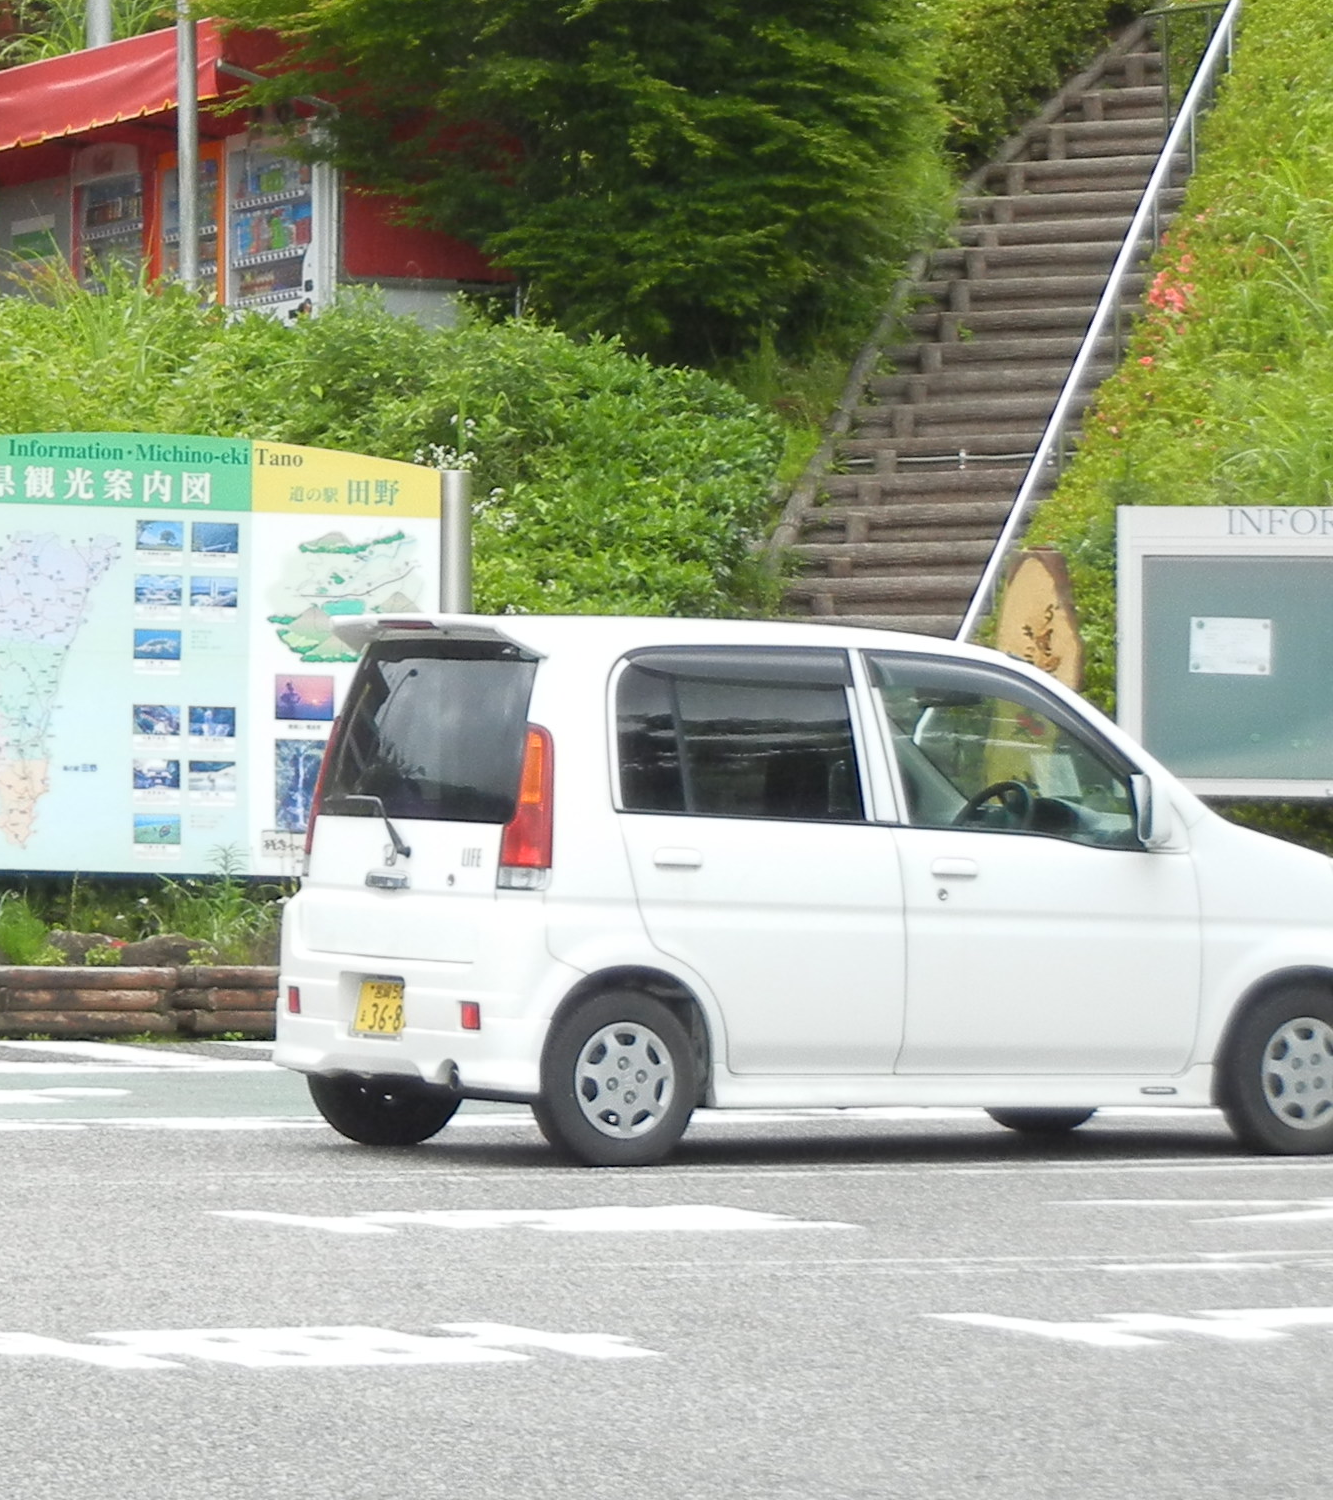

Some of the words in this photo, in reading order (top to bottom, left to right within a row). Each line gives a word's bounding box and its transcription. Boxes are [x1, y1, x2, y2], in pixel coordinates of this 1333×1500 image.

[8, 439, 124, 460] Information
[134, 443, 249, 466] Michino-eki
[255, 448, 304, 468] Tano
[289, 485, 339, 504] 道の駅
[346, 479, 400, 506] 田野
[461, 847, 482, 868] LIFE
